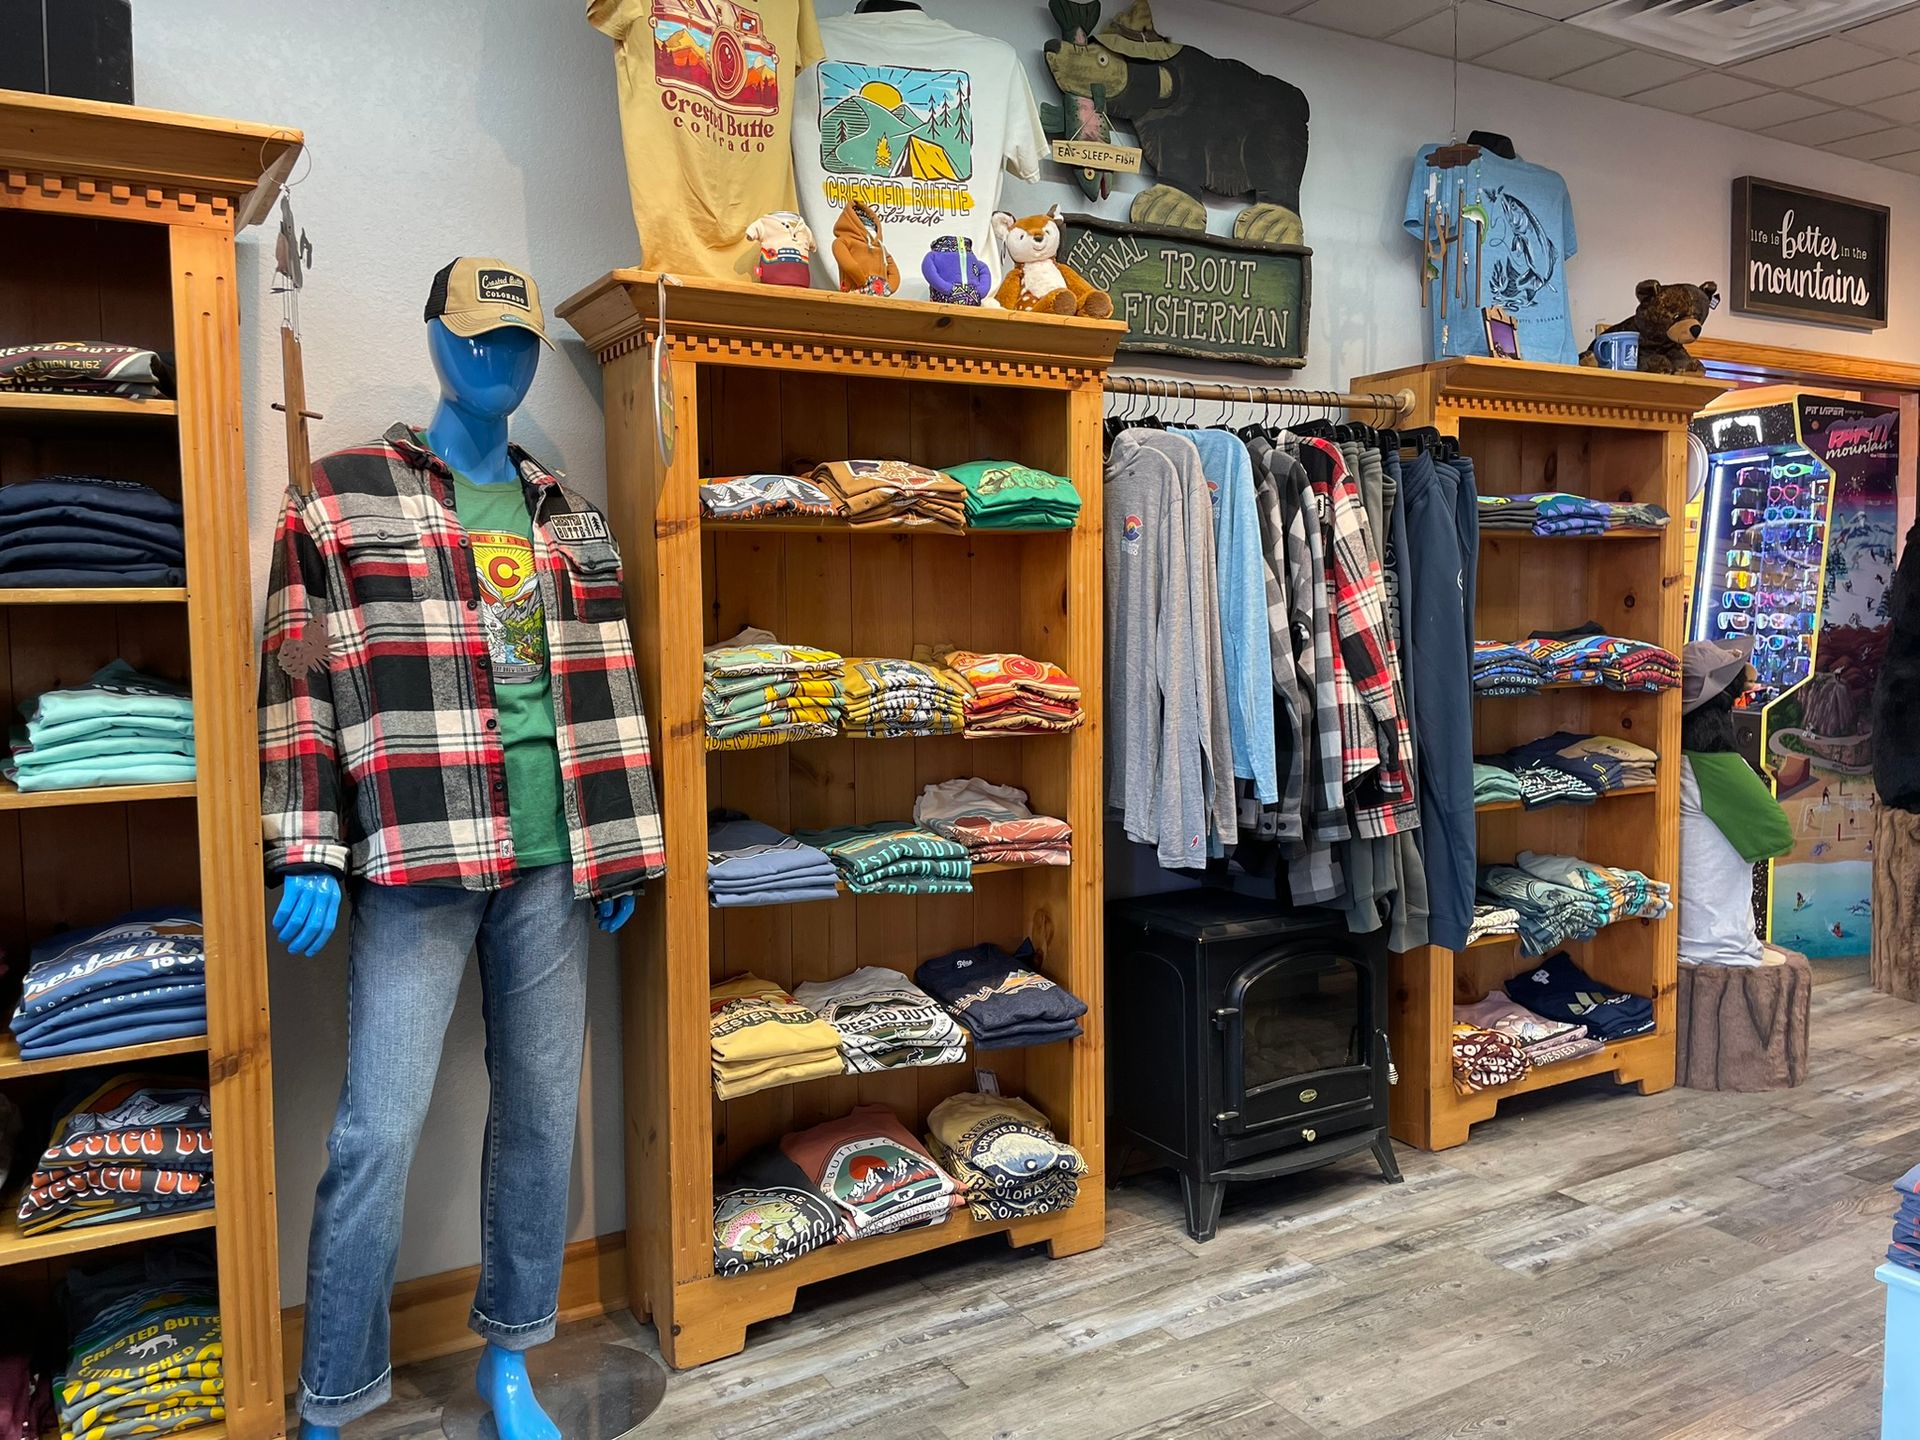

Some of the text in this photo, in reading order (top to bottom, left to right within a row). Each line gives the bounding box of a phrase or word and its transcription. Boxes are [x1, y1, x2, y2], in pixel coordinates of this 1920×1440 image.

[726, 113, 775, 138] Butte
[826, 175, 970, 217] CRESTED BUTTE
[1066, 229, 1101, 274] THE
[1750, 209, 1868, 261] life is better in the
[1087, 233, 1149, 293] GINAL
[1160, 249, 1258, 299] TROUT
[485, 290, 525, 304] COLORADO
[1750, 260, 1870, 307] mountains
[1122, 292, 1290, 349] FISHERMAN
[0, 345, 67, 358] RESTED
[13, 359, 66, 375] ELEVATION
[1825, 432, 1895, 460] mountain
[857, 840, 966, 874] ESTED BUTT
[23, 945, 140, 998] rested
[709, 1010, 773, 1037] RESTED
[779, 1010, 818, 1021] BUT
[976, 1123, 1018, 1153] CRESTED
[828, 1143, 863, 1179] BUTTE
[889, 1199, 947, 1223] MOUNTAINS
[81, 1316, 221, 1367] CRESTED BUTTE
[78, 1345, 196, 1380] ESTABLISHED
